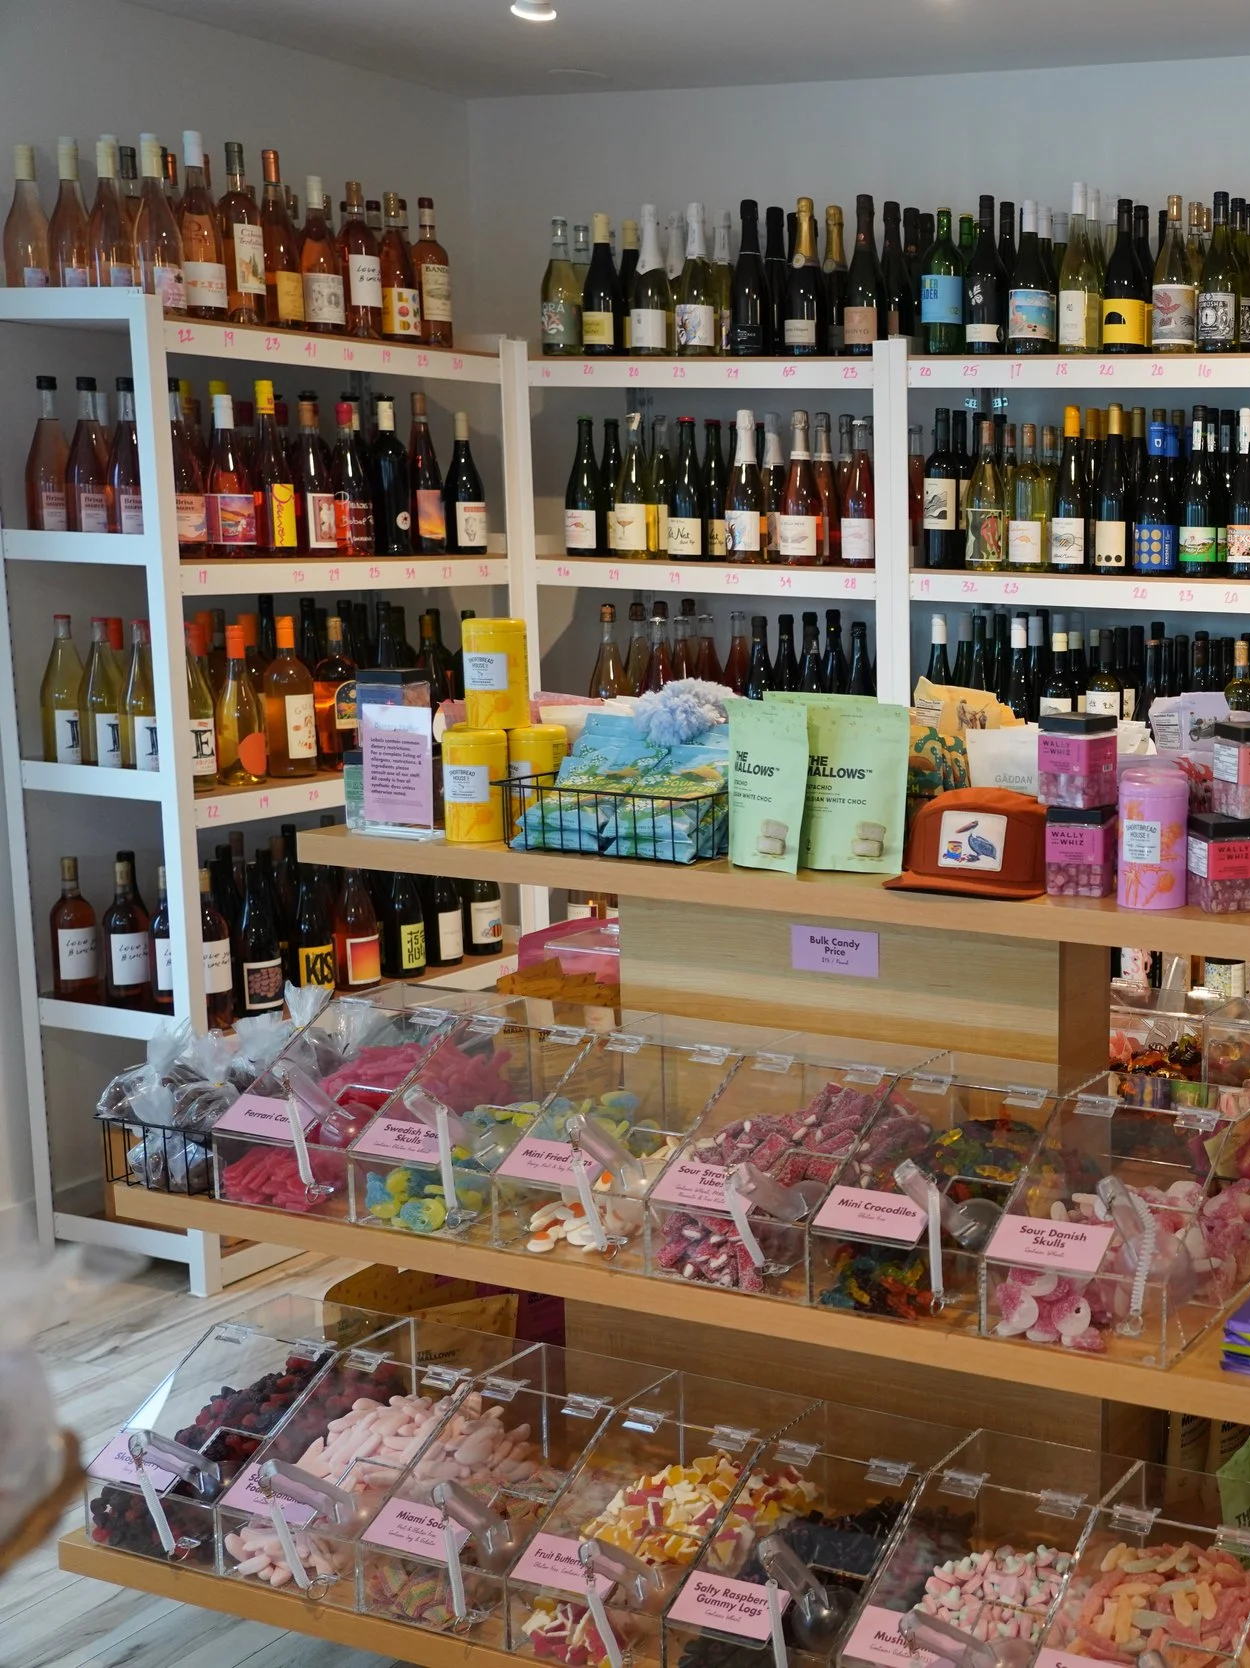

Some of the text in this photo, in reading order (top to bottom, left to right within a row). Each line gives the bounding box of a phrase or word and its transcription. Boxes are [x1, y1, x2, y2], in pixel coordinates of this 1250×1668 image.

[178, 329, 194, 342] 22
[224, 331, 234, 345] 19
[265, 337, 280, 351] 23
[305, 343, 317, 357] 41
[628, 366, 639, 378] 20
[673, 366, 686, 378] 23
[783, 366, 797, 377] 65
[843, 366, 858, 378] 25
[963, 365, 979, 377] 25
[199, 570, 207, 584] 17
[329, 568, 340, 582] 29
[369, 567, 380, 580] 25
[404, 568, 416, 580] 34
[844, 578, 856, 589] 28
[920, 578, 930, 593] 19
[962, 580, 977, 593] 32
[1004, 582, 1018, 594] 23
[1180, 588, 1194, 601] 23
[1042, 740, 1071, 748] WALLY
[1050, 748, 1071, 756] WHIZ
[808, 756, 829, 766] THE
[807, 766, 866, 780] MALLOWS
[259, 795, 269, 809] 19
[847, 798, 867, 806] CHOC
[809, 935, 861, 950] Bulk Candy
[824, 946, 847, 957] Price
[244, 1109, 274, 1121] Ferrari
[384, 1124, 422, 1137] Swedish
[395, 1134, 422, 1145] Skulls
[522, 1149, 570, 1164] Mini Fried
[678, 1165, 700, 1175] Sour
[838, 1198, 861, 1210] Mini
[864, 1200, 917, 1218] Crocodiles
[1019, 1225, 1088, 1243] Sour Danish
[1032, 1235, 1066, 1249] Skulls
[396, 1511, 426, 1524] Miami
[535, 1548, 553, 1560] Fruit
[694, 1583, 721, 1598] Salty
[696, 1594, 763, 1618] Gummy Logs
